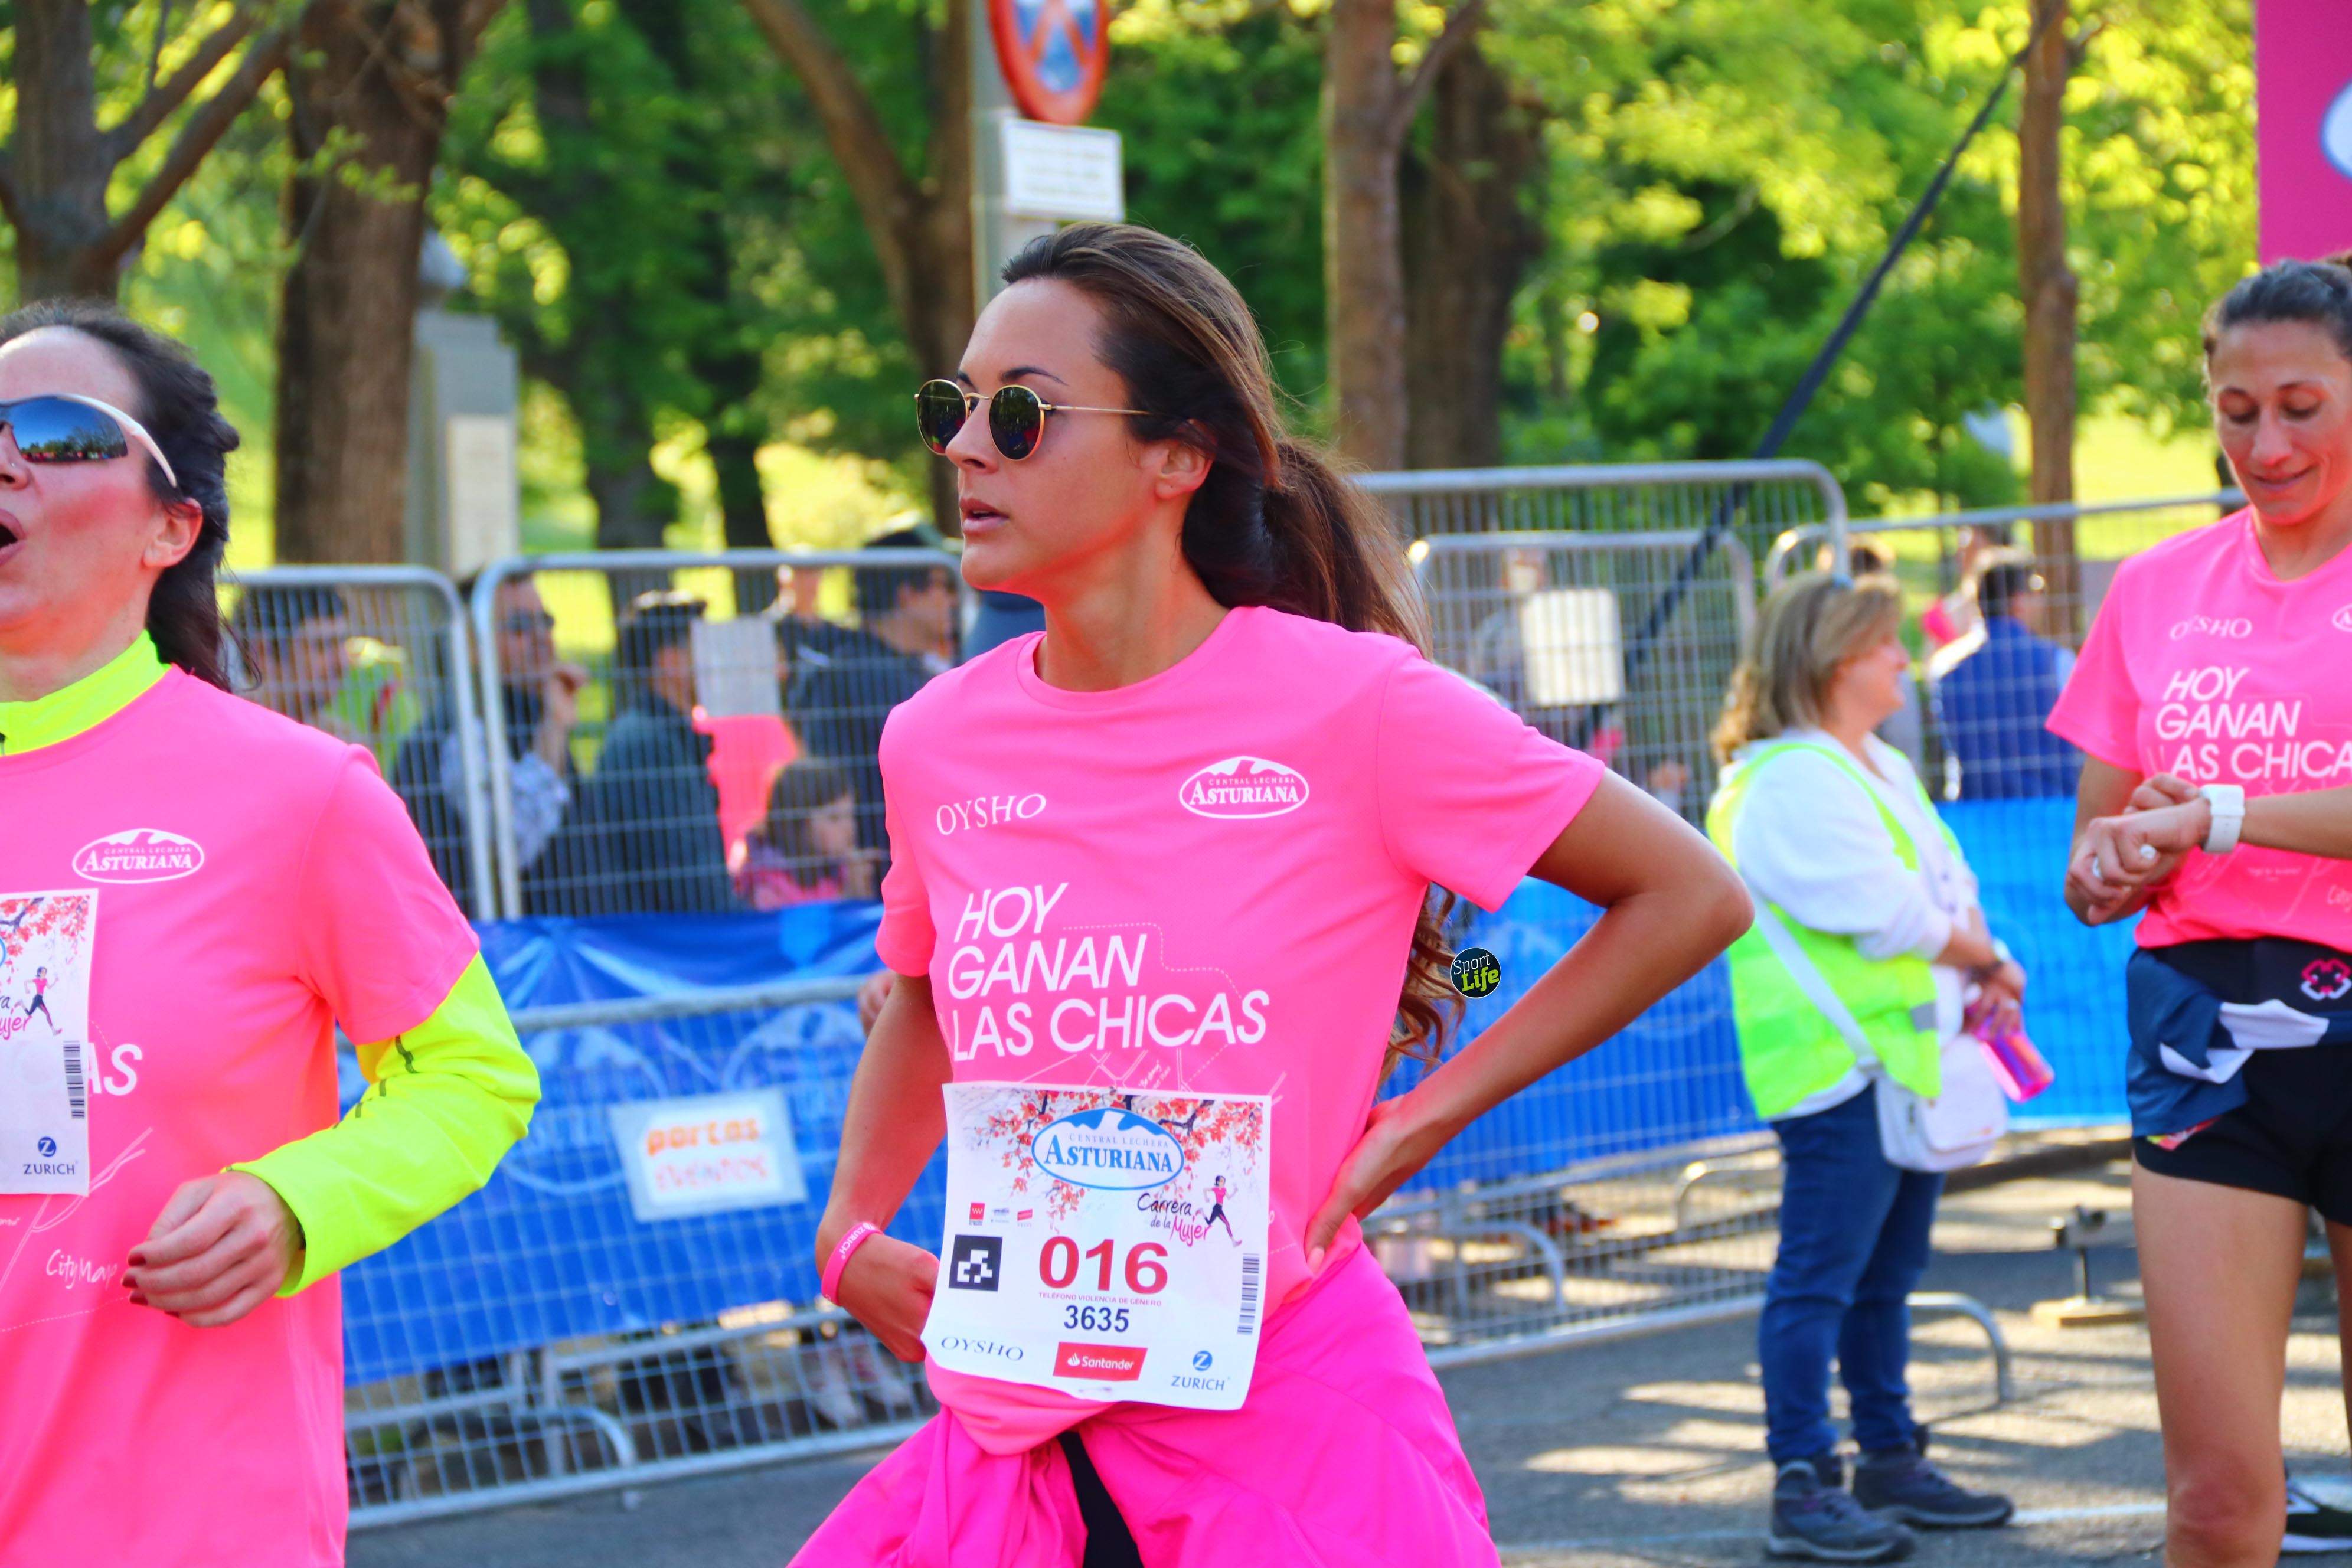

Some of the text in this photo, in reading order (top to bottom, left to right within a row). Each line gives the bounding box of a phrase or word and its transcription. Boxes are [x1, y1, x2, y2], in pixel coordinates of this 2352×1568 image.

[2163, 666, 2250, 701] HOY
[2155, 701, 2301, 740] GANAN
[1189, 780, 1299, 805] ASTURIANA
[1209, 778, 1249, 786] CENTRAL
[936, 793, 1046, 835] OYSHO
[81, 850, 192, 871] ASTURIANA
[954, 883, 1069, 943] HOY
[948, 933, 1147, 999] GANAN
[952, 989, 1270, 1062] LAS CHICAS
[1044, 1134, 1173, 1172] ASTURIANA
[1069, 1133, 1168, 1148] CENTRAL LECHERA
[23, 1163, 76, 1175] ZURICH
[1137, 1193, 1191, 1216] Carrera
[1150, 1214, 1171, 1229] de la
[1169, 1214, 1212, 1247] Mujer
[839, 1226, 866, 1255] ZURICH
[1039, 1236, 1169, 1295] 016
[1038, 1292, 1077, 1300] TELÉFONO
[1078, 1294, 1117, 1304] VIOLENCIA
[1064, 1305, 1129, 1333] 3635
[941, 1337, 1024, 1361] OYSHO
[1082, 1355, 1134, 1370] Santander
[1171, 1376, 1226, 1391] ZURICH
